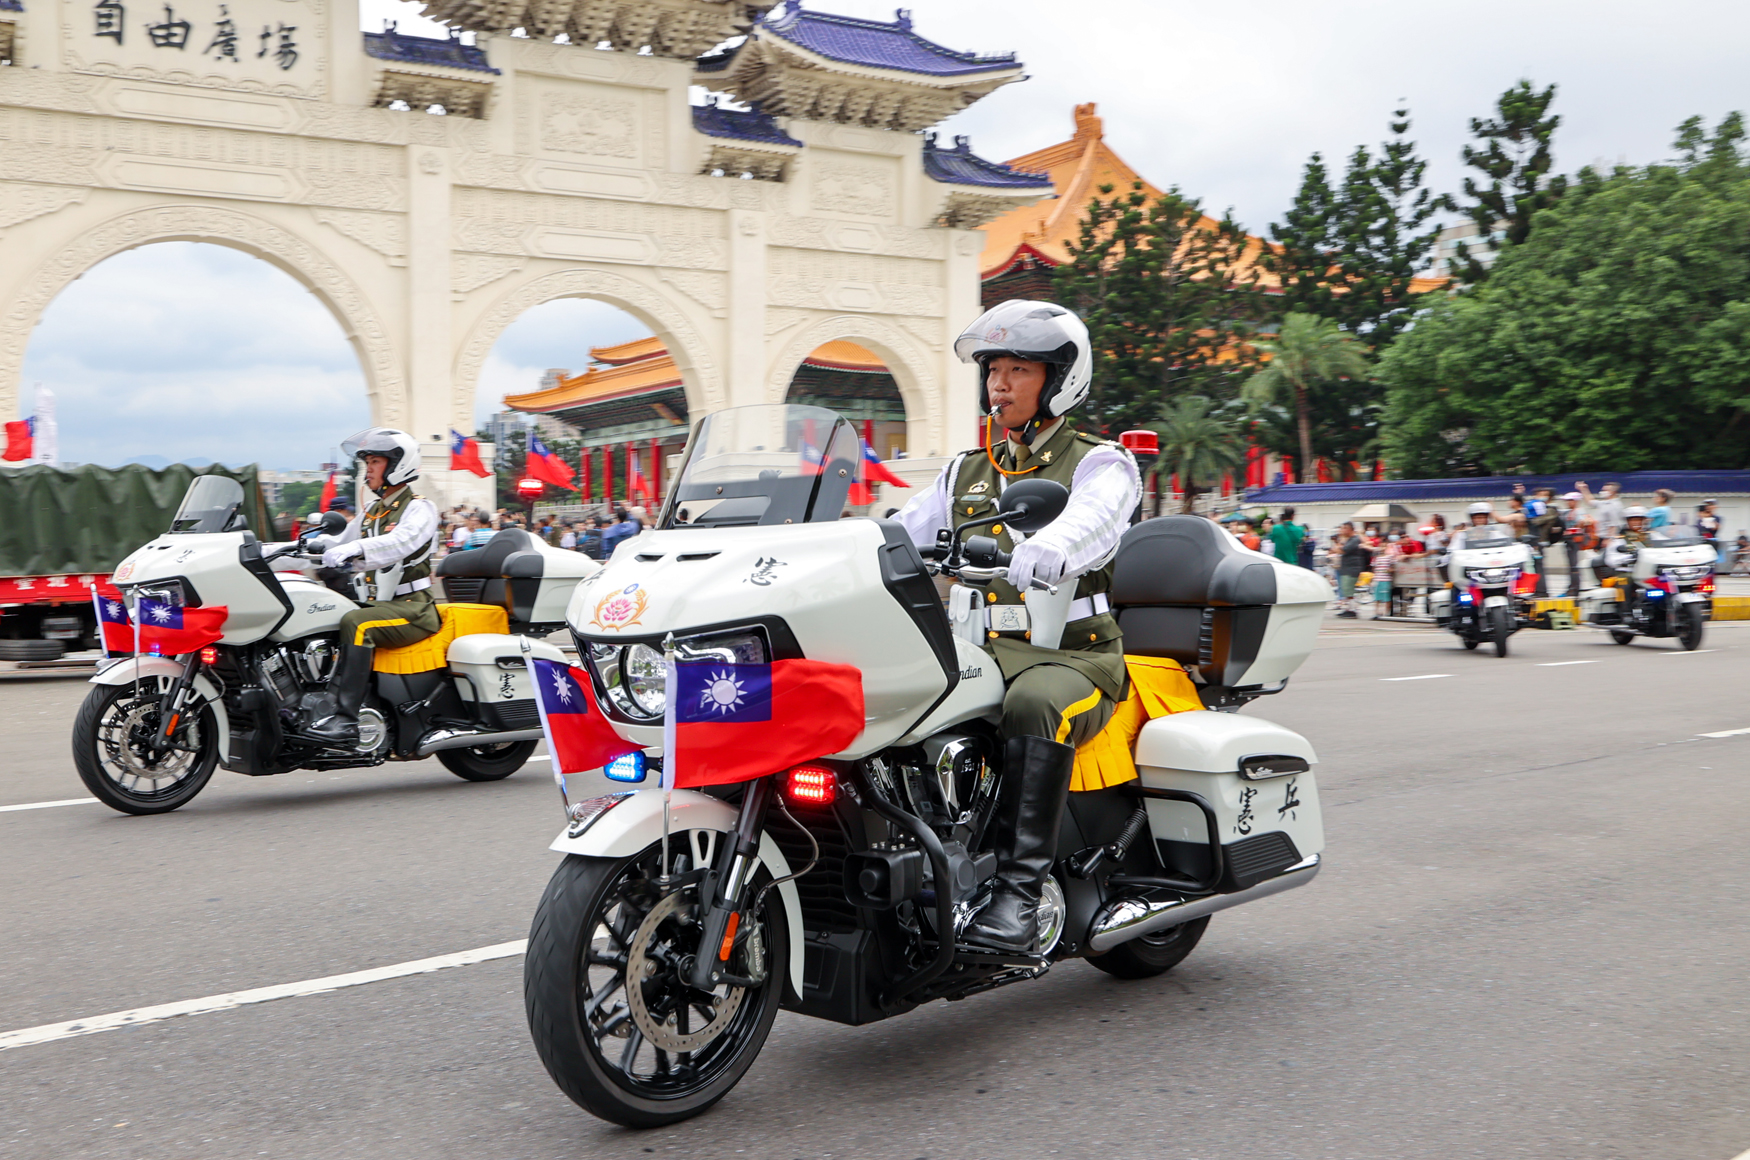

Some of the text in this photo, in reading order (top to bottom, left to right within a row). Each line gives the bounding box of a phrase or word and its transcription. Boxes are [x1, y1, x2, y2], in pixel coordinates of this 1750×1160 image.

[93, 0, 298, 71] 自由廣場
[306, 602, 337, 614] Indian
[960, 665, 982, 680] ndian
[753, 937, 762, 972] brembo
